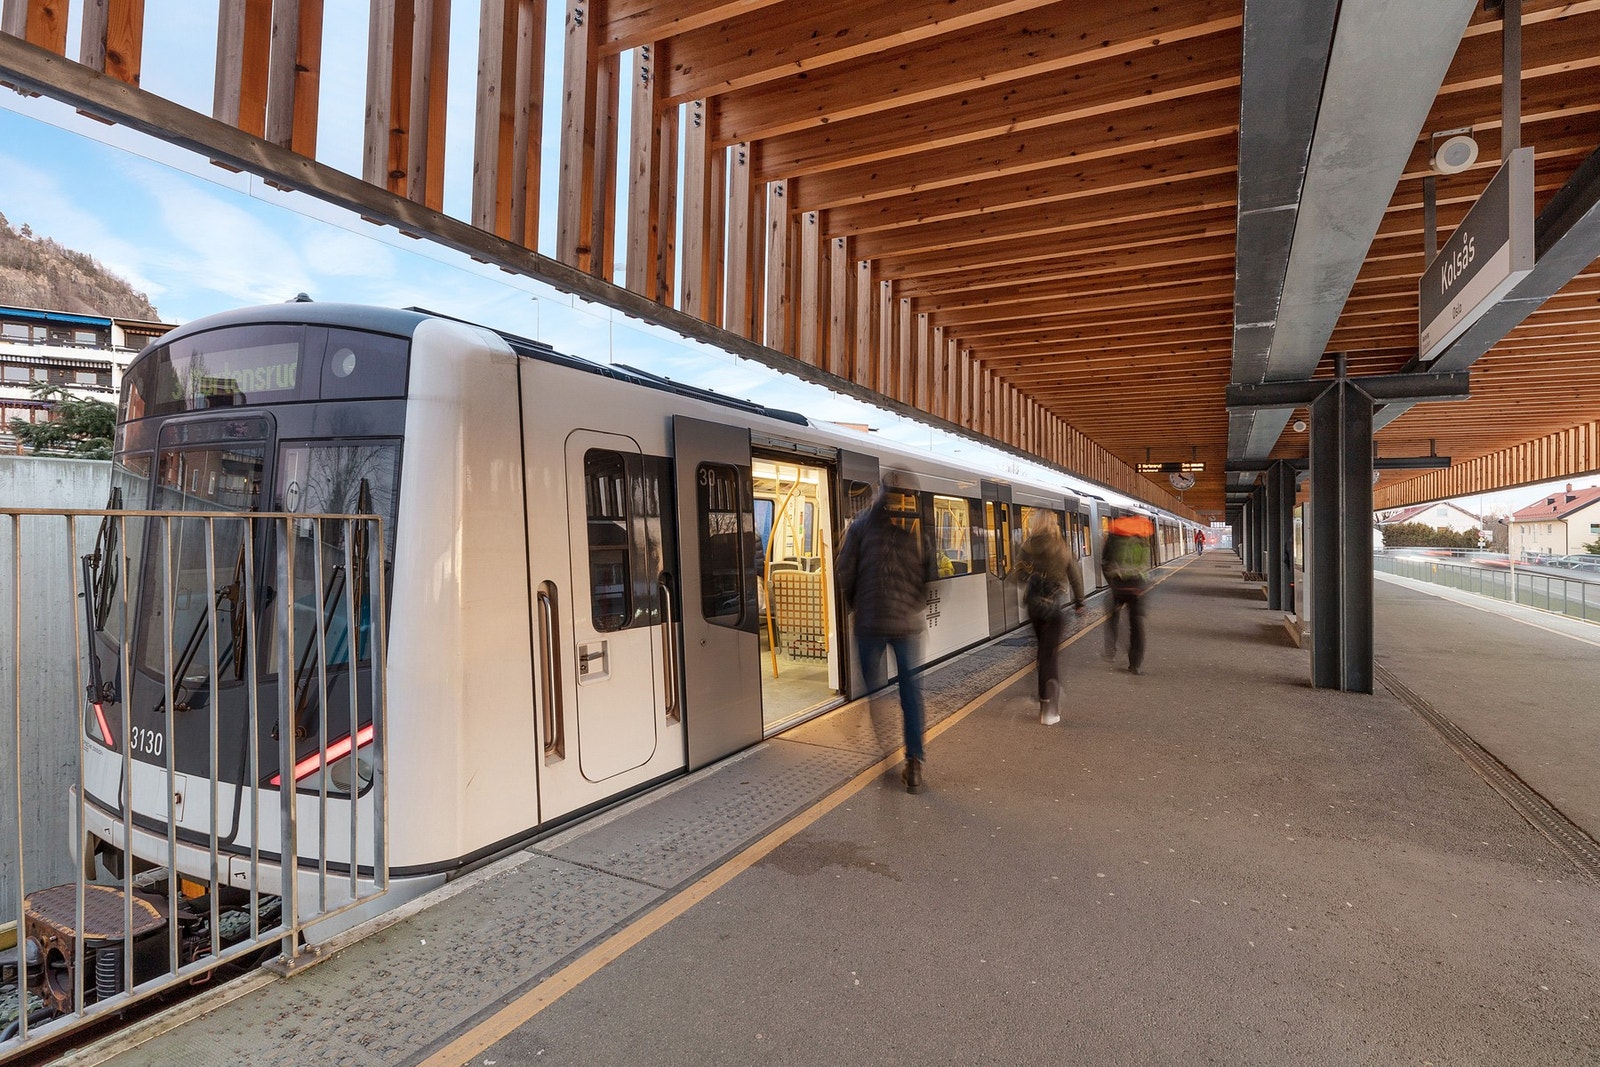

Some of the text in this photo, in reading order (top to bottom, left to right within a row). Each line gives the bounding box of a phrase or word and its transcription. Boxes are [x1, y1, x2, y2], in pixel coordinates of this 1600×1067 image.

[1441, 232, 1475, 295] Kolsås
[699, 469, 715, 487] 30
[130, 726, 163, 756] 3130
